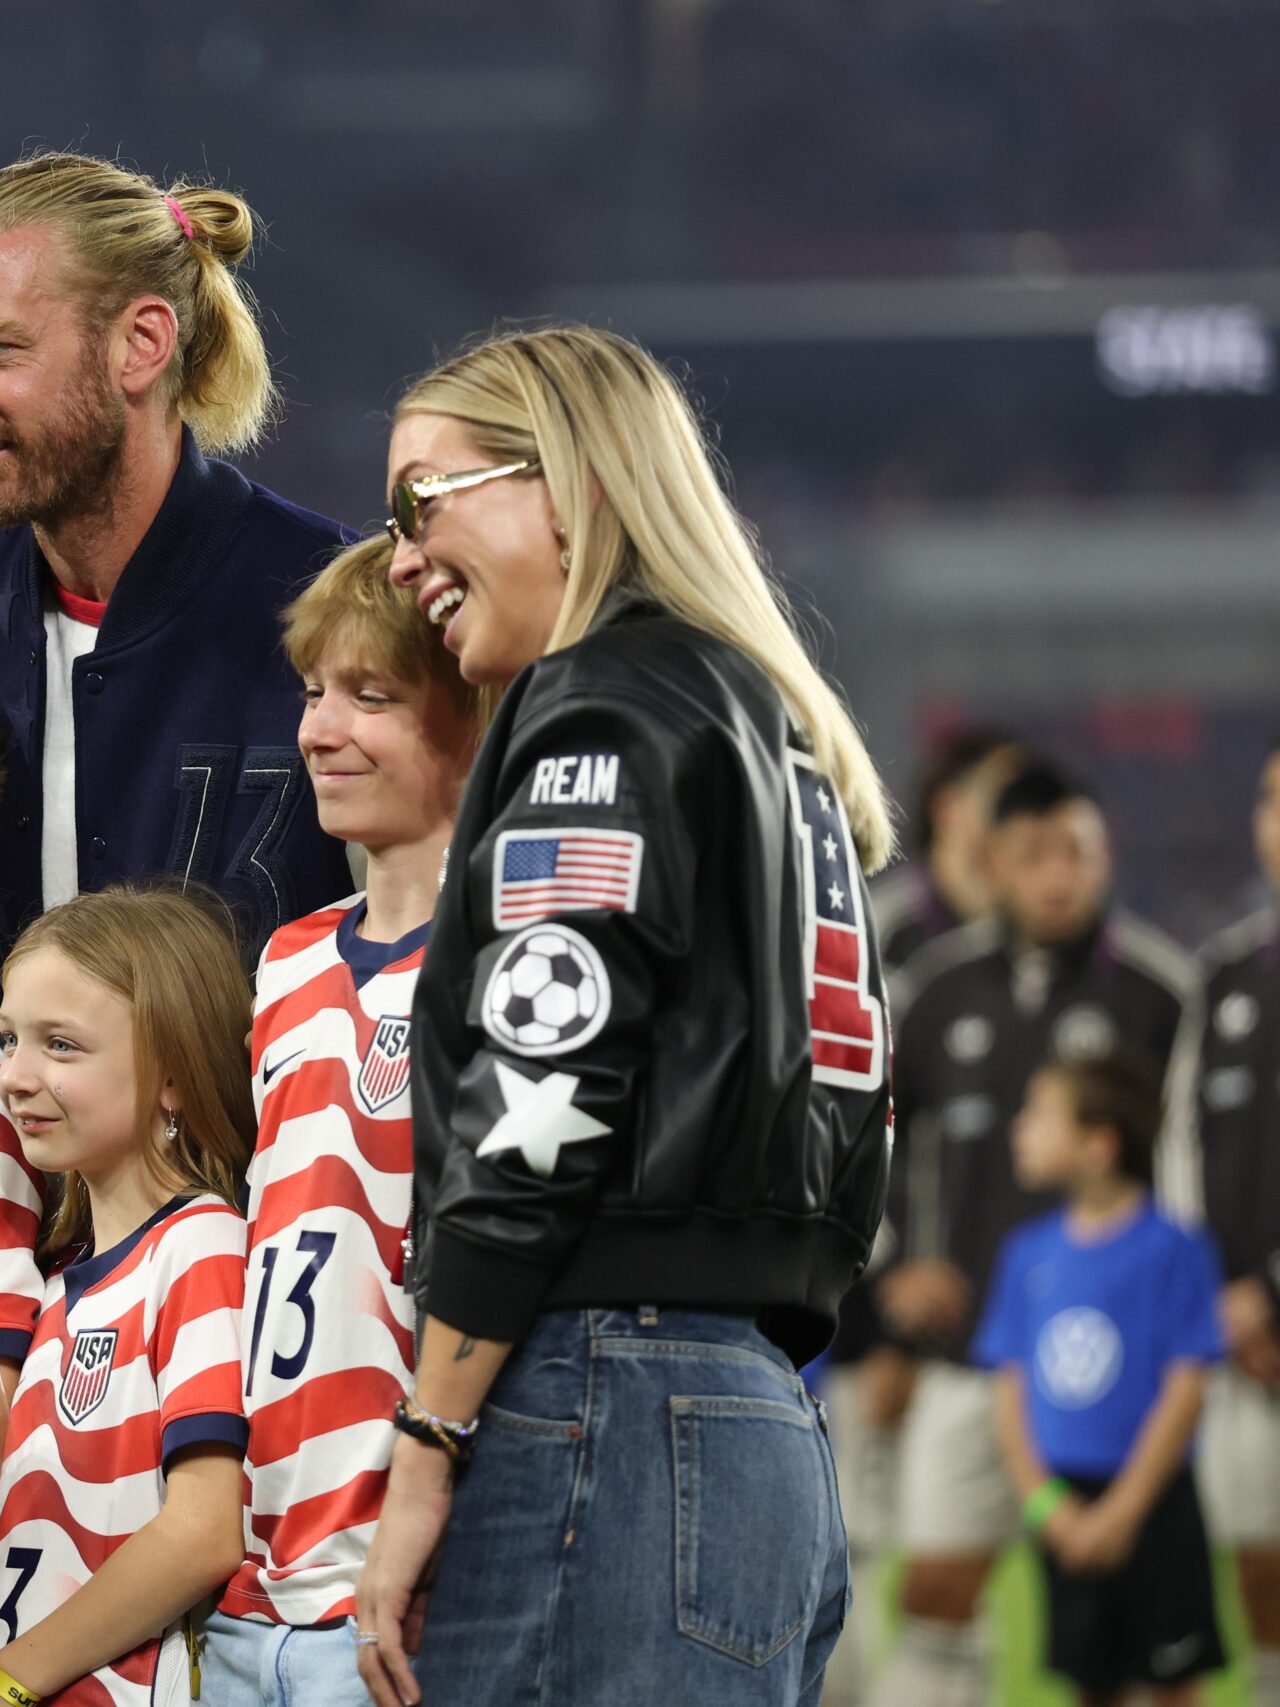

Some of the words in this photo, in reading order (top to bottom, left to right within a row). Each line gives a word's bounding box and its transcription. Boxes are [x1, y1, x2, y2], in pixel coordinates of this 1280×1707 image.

[529, 755, 620, 806] REAM
[245, 1230, 337, 1397] 13
[76, 1336, 114, 1370] USA
